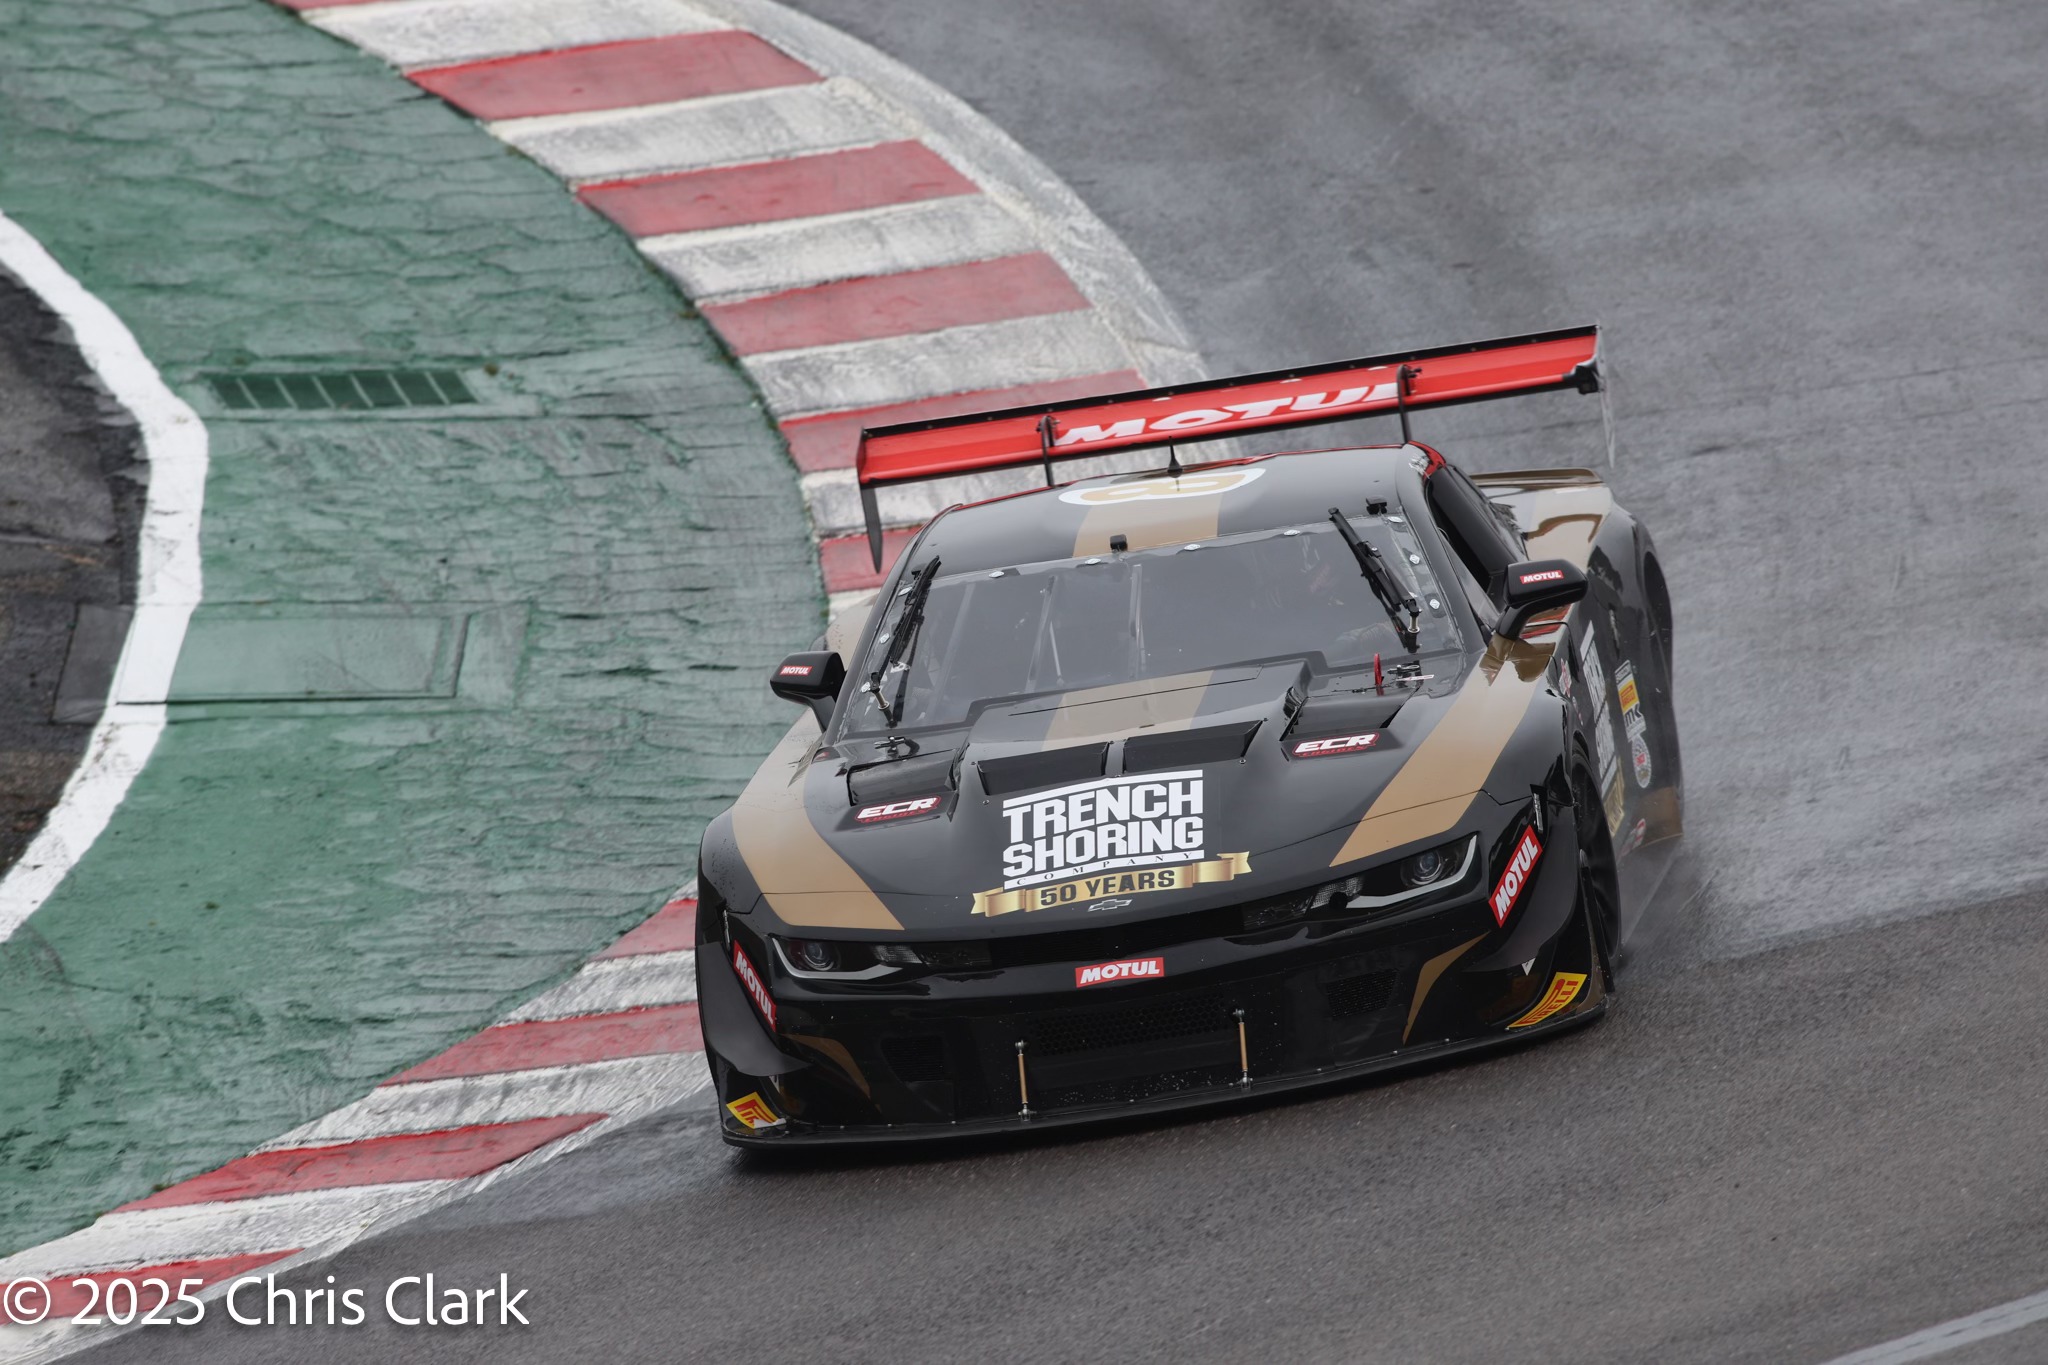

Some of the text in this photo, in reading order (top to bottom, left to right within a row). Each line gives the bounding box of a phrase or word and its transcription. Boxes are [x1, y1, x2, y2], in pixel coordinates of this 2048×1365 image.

[1523, 571, 1562, 583] MOTUL
[780, 666, 809, 675] MOTUL
[1294, 733, 1376, 754] ECR
[857, 797, 937, 819] ECR
[1002, 779, 1204, 844] TRENCH
[1002, 815, 1204, 878] SHORING
[1016, 851, 1193, 887] COMPANY
[1494, 835, 1539, 921] MOTUL
[1040, 869, 1176, 907] 50 YEARS
[735, 950, 774, 1025] MOTUL
[1080, 960, 1160, 984] MOTUL
